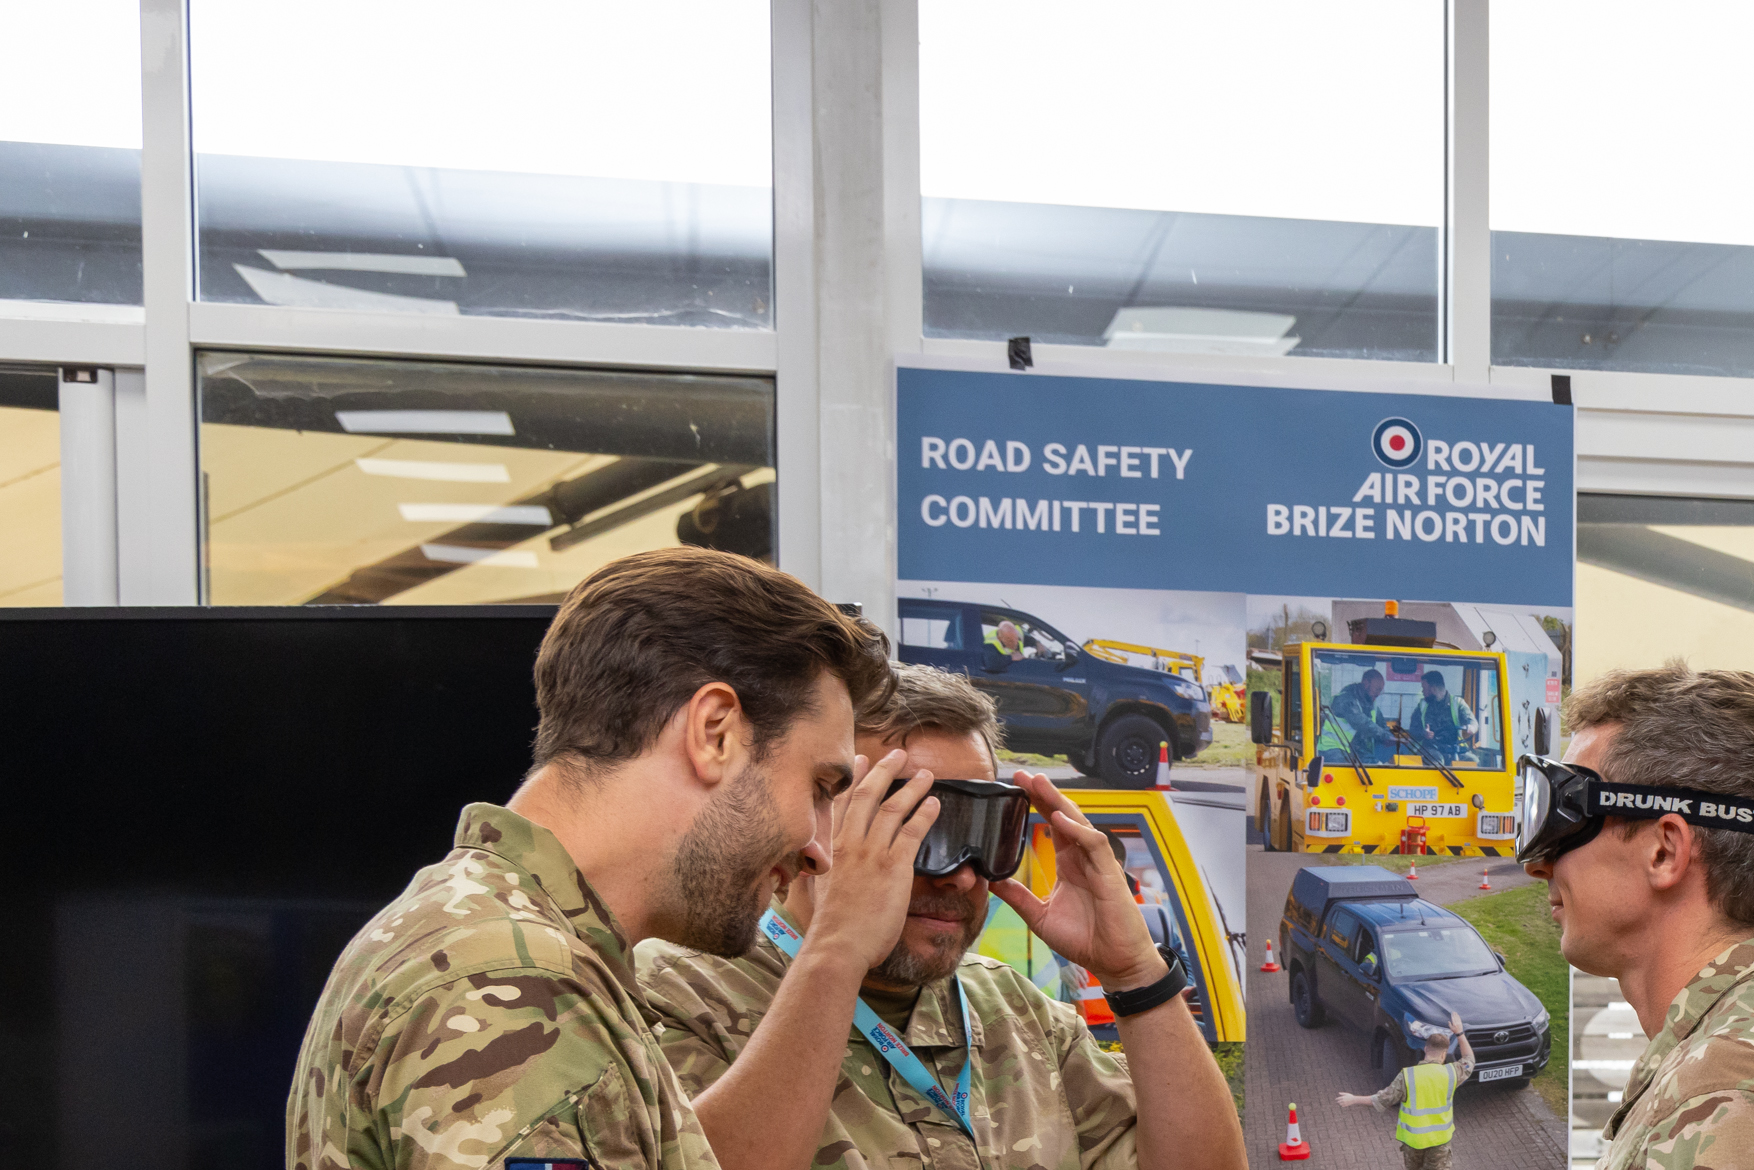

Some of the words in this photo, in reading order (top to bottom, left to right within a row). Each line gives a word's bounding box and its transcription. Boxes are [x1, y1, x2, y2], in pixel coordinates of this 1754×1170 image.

[921, 436, 1032, 473] ROAD
[1042, 443, 1193, 480] SAFETY
[1427, 439, 1545, 476] ROYAL
[1352, 472, 1422, 505] AIR
[1427, 475, 1545, 511] FORCE
[920, 494, 1161, 535] COMMITTEE
[1266, 503, 1376, 539] BRIZE
[1386, 508, 1546, 547] NORTON
[1414, 805, 1428, 815] HP
[1431, 805, 1445, 815] 97
[1448, 805, 1461, 816] AB
[1600, 791, 1693, 814] DRUNK
[876, 1022, 897, 1044] NORTON
[1504, 1067, 1520, 1076] HFP
